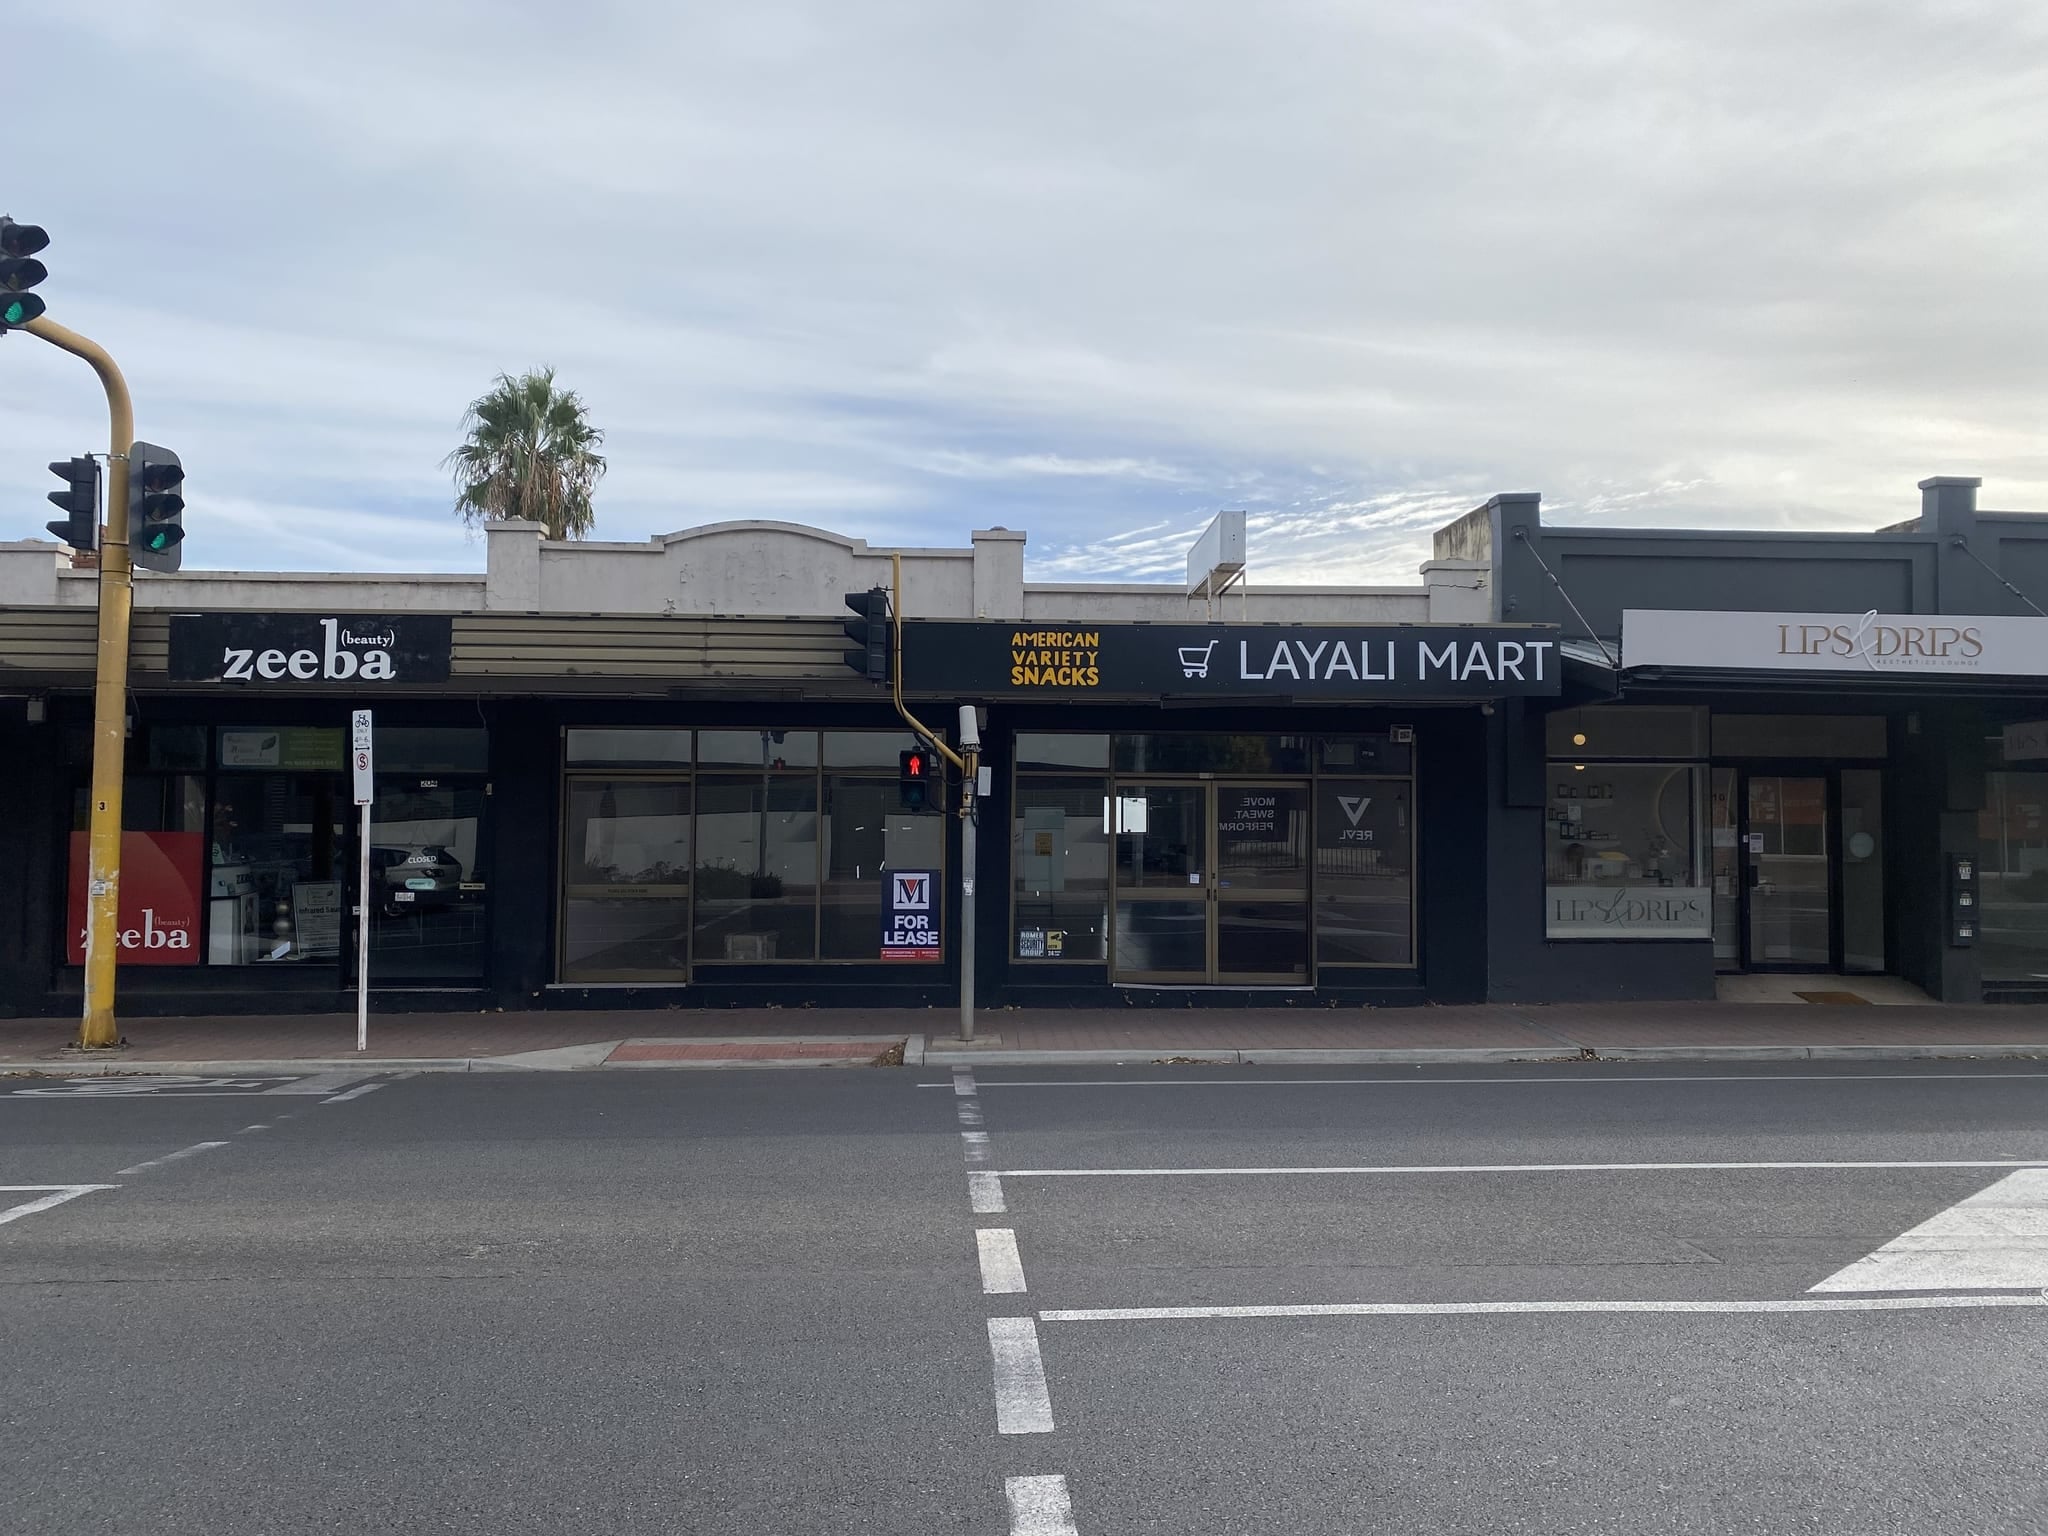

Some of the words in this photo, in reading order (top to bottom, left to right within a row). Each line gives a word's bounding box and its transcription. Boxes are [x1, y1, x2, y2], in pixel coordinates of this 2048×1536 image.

[341, 629, 395, 648] (beauty)
[1011, 632, 1099, 648] AMERICAN
[223, 618, 396, 680] zeeba
[1012, 650, 1098, 667] VARIETY
[1240, 641, 1394, 680] LAYALI
[1418, 641, 1553, 681] MART
[1011, 667, 1099, 686] SNACKS
[99, 802, 106, 811] 3
[408, 855, 437, 864] CLOSED
[154, 915, 190, 928] (beauty)
[894, 915, 929, 929] FOR
[884, 931, 939, 945] LEASE
